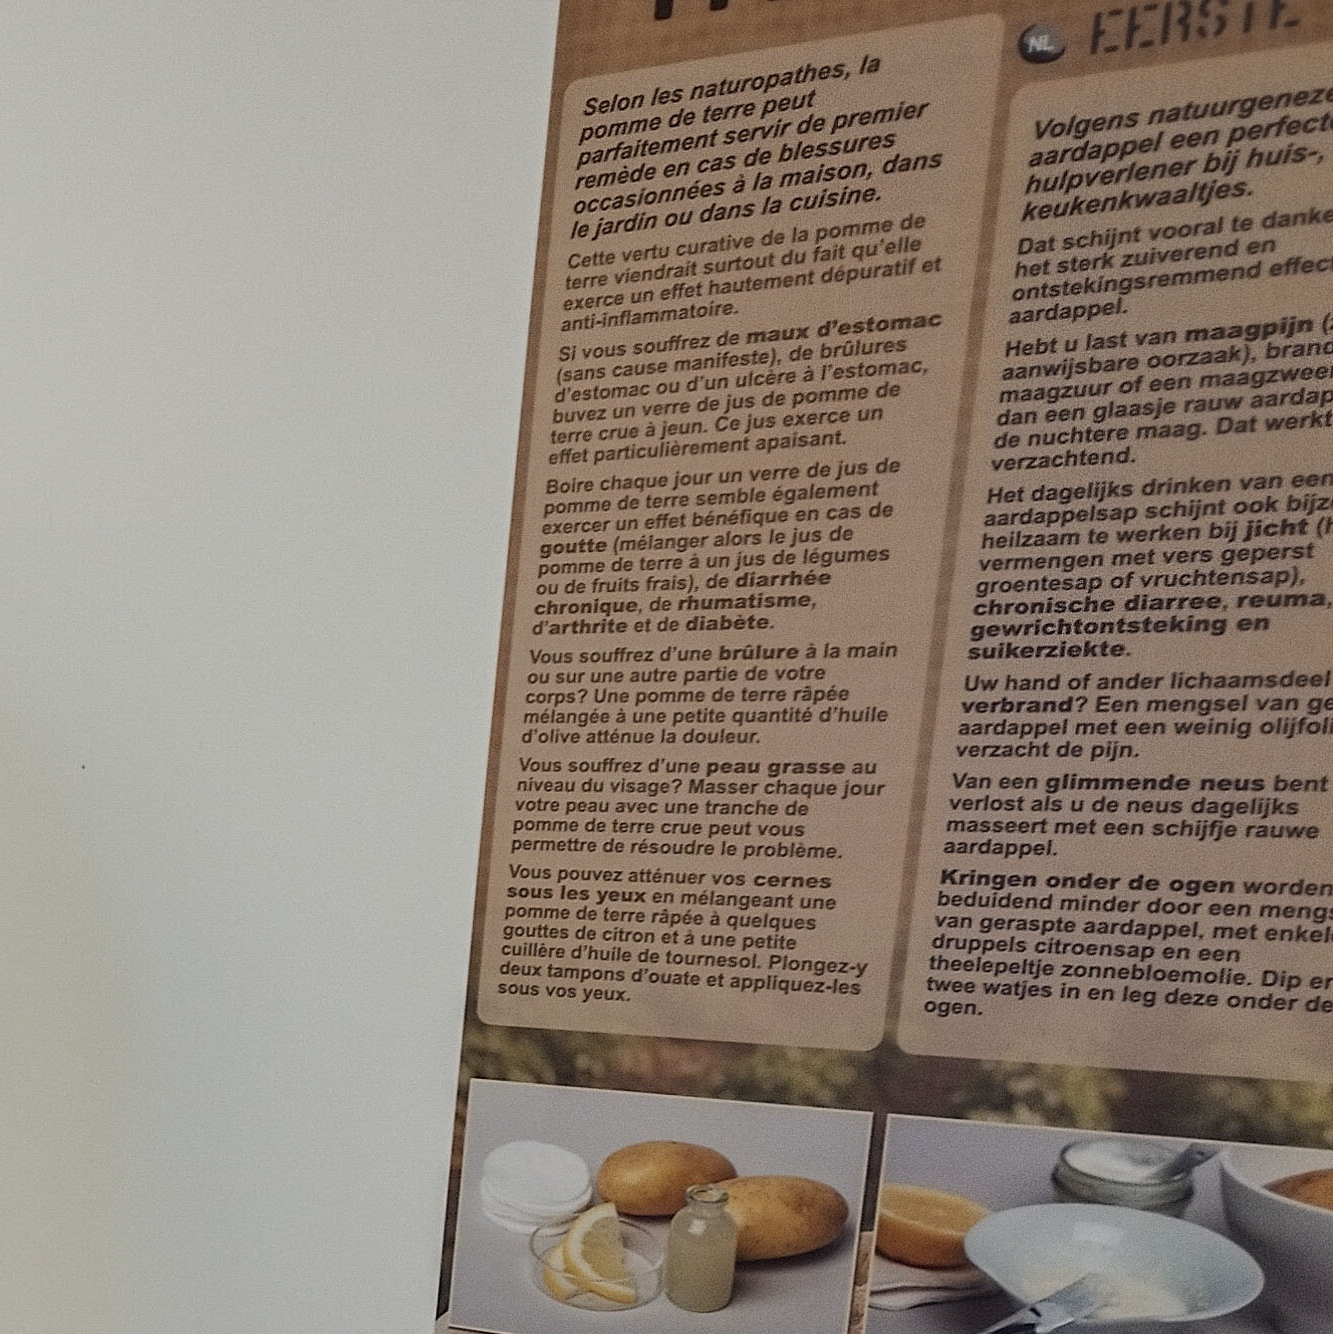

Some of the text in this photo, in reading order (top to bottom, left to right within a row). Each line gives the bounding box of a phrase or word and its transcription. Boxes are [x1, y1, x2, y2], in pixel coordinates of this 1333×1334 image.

[1027, 34, 1055, 54] NL
[582, 54, 881, 117] Selon les naturopathes, la
[577, 89, 817, 147] pomme de terre peut
[575, 101, 930, 171] parfaitement servir de premier
[574, 133, 897, 191] remède en cas de blessures
[1024, 143, 1324, 196] hulpverlener bij huis-,
[573, 153, 943, 215] occasionnées à la maison, dans
[1020, 179, 1253, 222] keukenkwaaltjes.
[570, 185, 881, 242] le jardin ou dans la cuisine.
[1014, 238, 1277, 279] het sterk zuiverend en
[1007, 296, 1128, 325] aardappel.
[991, 445, 1136, 472] verzachtend.
[539, 524, 854, 560] goutte (mélanger alors le jus de
[978, 542, 1315, 574] vermengen met vers geperst
[975, 565, 1305, 599] groentesap of vruchtensap),
[970, 614, 1270, 643] gewrichtontsteking en
[967, 640, 1131, 661] suikerziekte.
[521, 727, 761, 745] d'olive atténue la douleur.
[949, 794, 1299, 820] verlost als u de neus dagelijks
[931, 933, 1241, 963] druppels citroensap en een
[497, 982, 631, 1004] sous vos yeux.
[923, 1000, 983, 1018] ogen.
